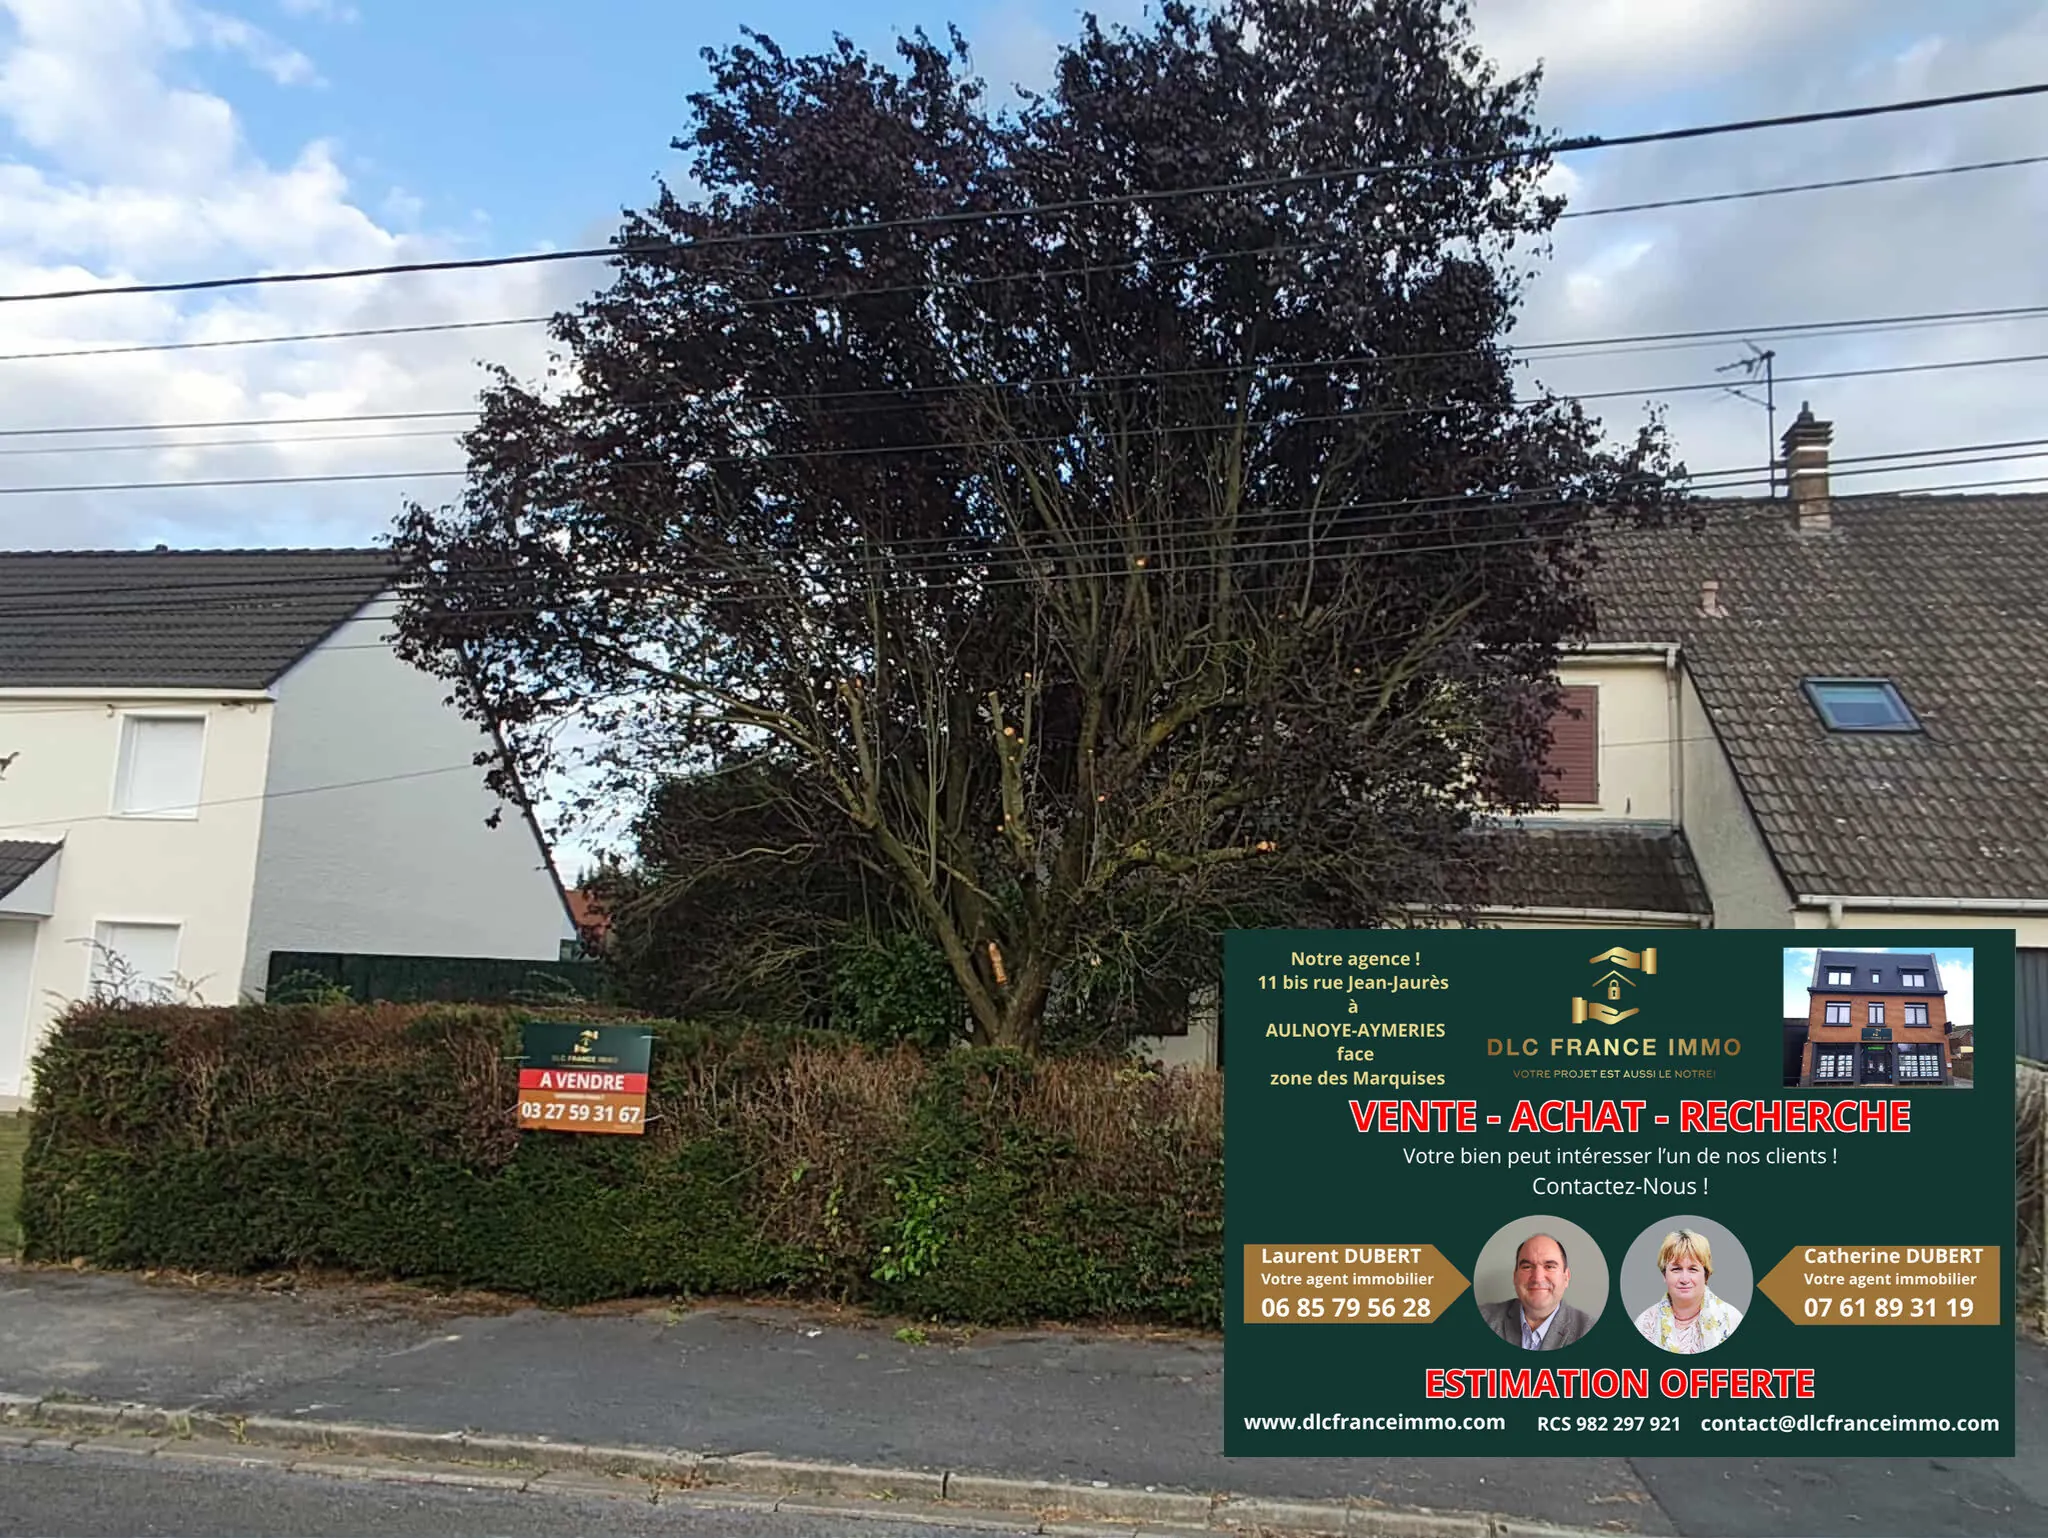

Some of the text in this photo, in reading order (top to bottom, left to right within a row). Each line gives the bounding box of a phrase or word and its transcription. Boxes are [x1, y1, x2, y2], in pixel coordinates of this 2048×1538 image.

[540, 1073, 625, 1090] A VENDRE
[521, 1102, 641, 1123] 03 27 59 31 67
